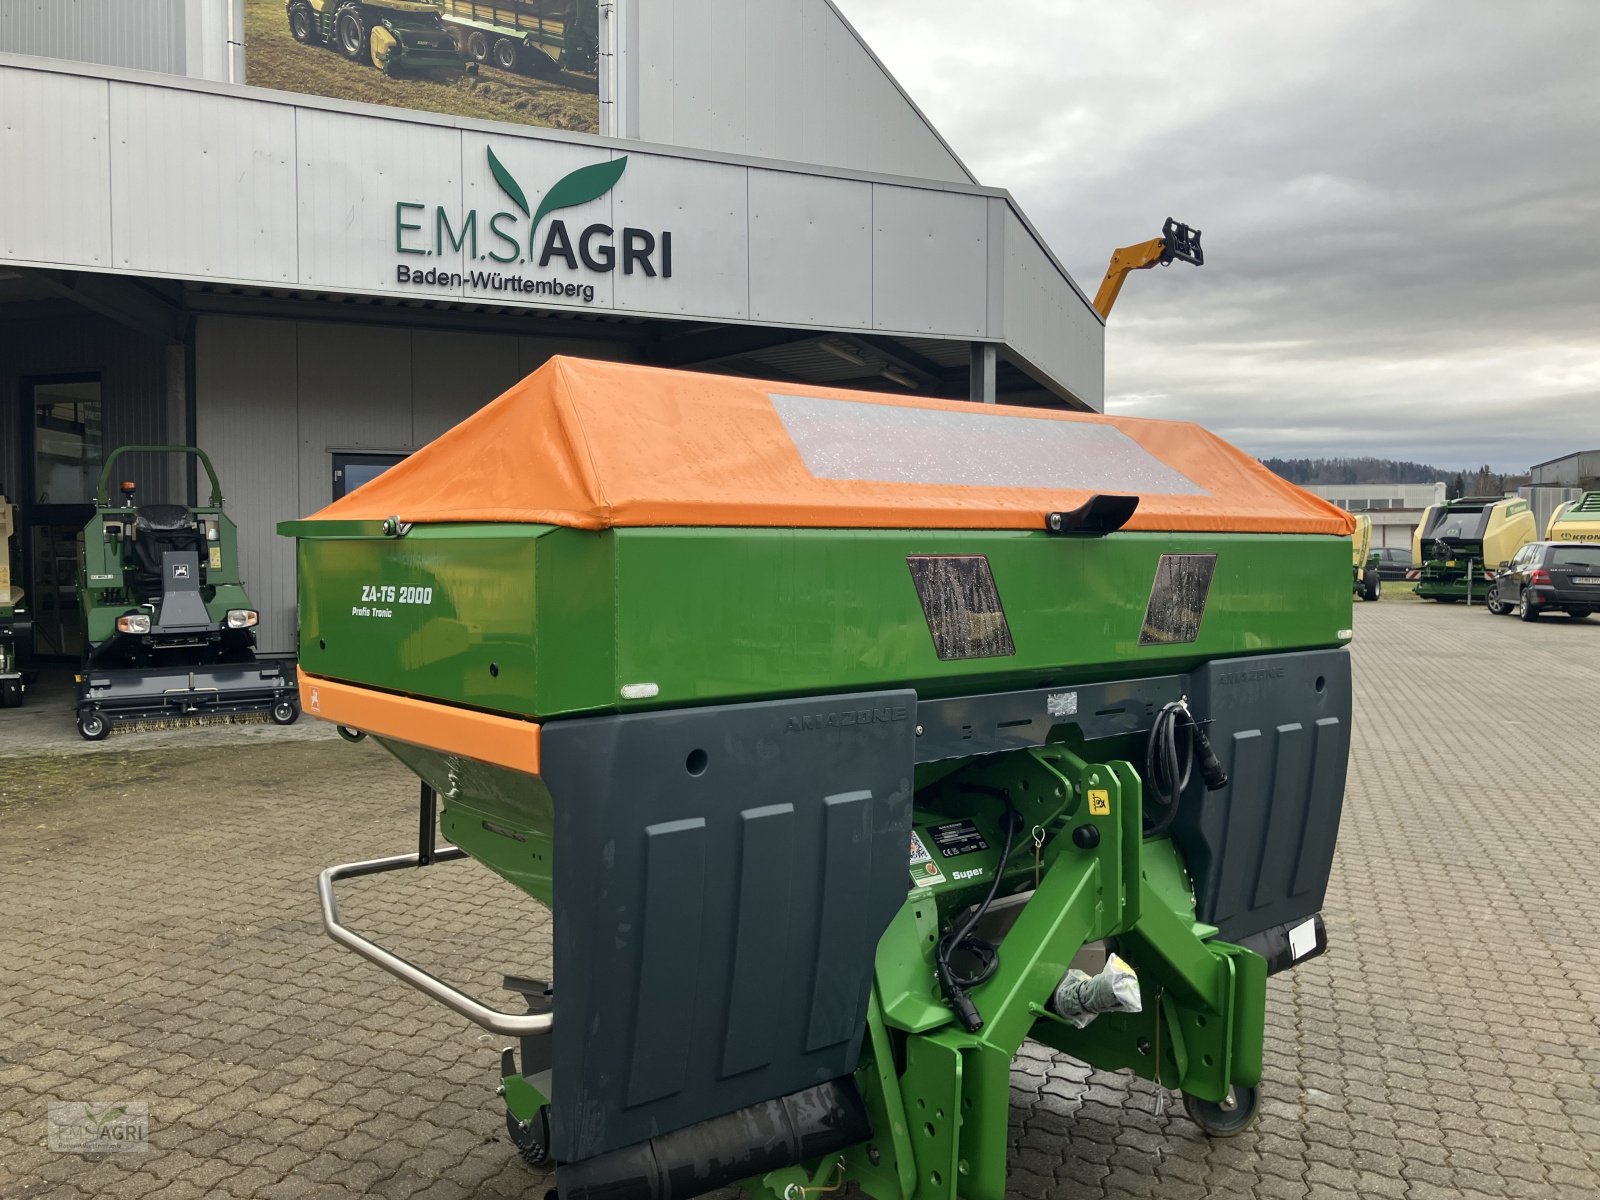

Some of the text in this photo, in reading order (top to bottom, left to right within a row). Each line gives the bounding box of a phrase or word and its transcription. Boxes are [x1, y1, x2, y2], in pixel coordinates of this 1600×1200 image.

[396, 201, 673, 278] E.M.S. AGRI
[396, 264, 595, 302] Baden-Württemberg
[361, 585, 433, 605] ZA-TS 2000
[351, 606, 393, 618] Profis Tronic
[783, 706, 906, 732] AMAZONE
[951, 867, 984, 880] Super
